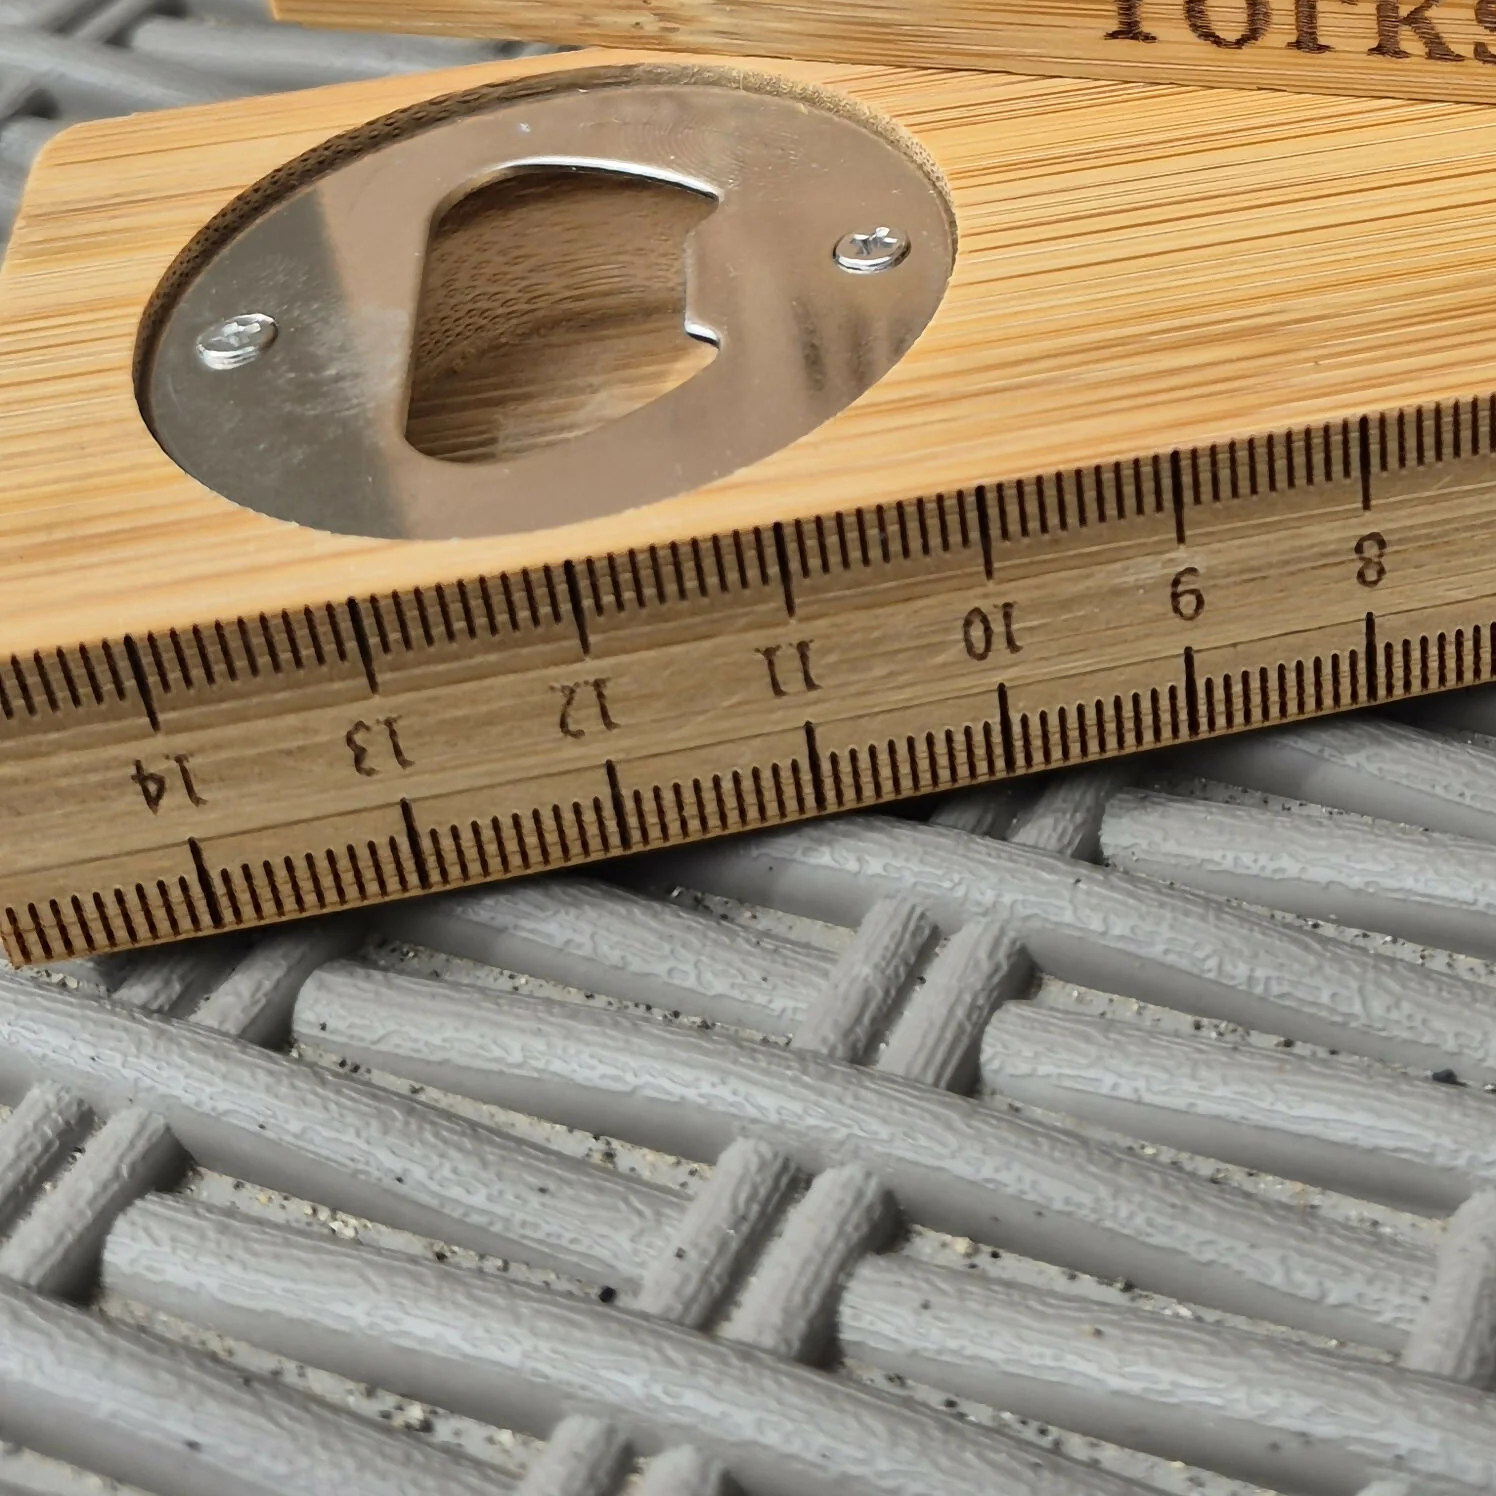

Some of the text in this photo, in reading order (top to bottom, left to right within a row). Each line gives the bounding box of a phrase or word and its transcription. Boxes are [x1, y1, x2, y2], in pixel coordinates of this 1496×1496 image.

[1353, 530, 1388, 588] 8
[1169, 565, 1205, 622] 9
[961, 600, 1024, 663] 10
[753, 637, 823, 698] 11
[549, 676, 622, 740] 12
[344, 714, 416, 778] 13
[130, 753, 208, 816] 14
